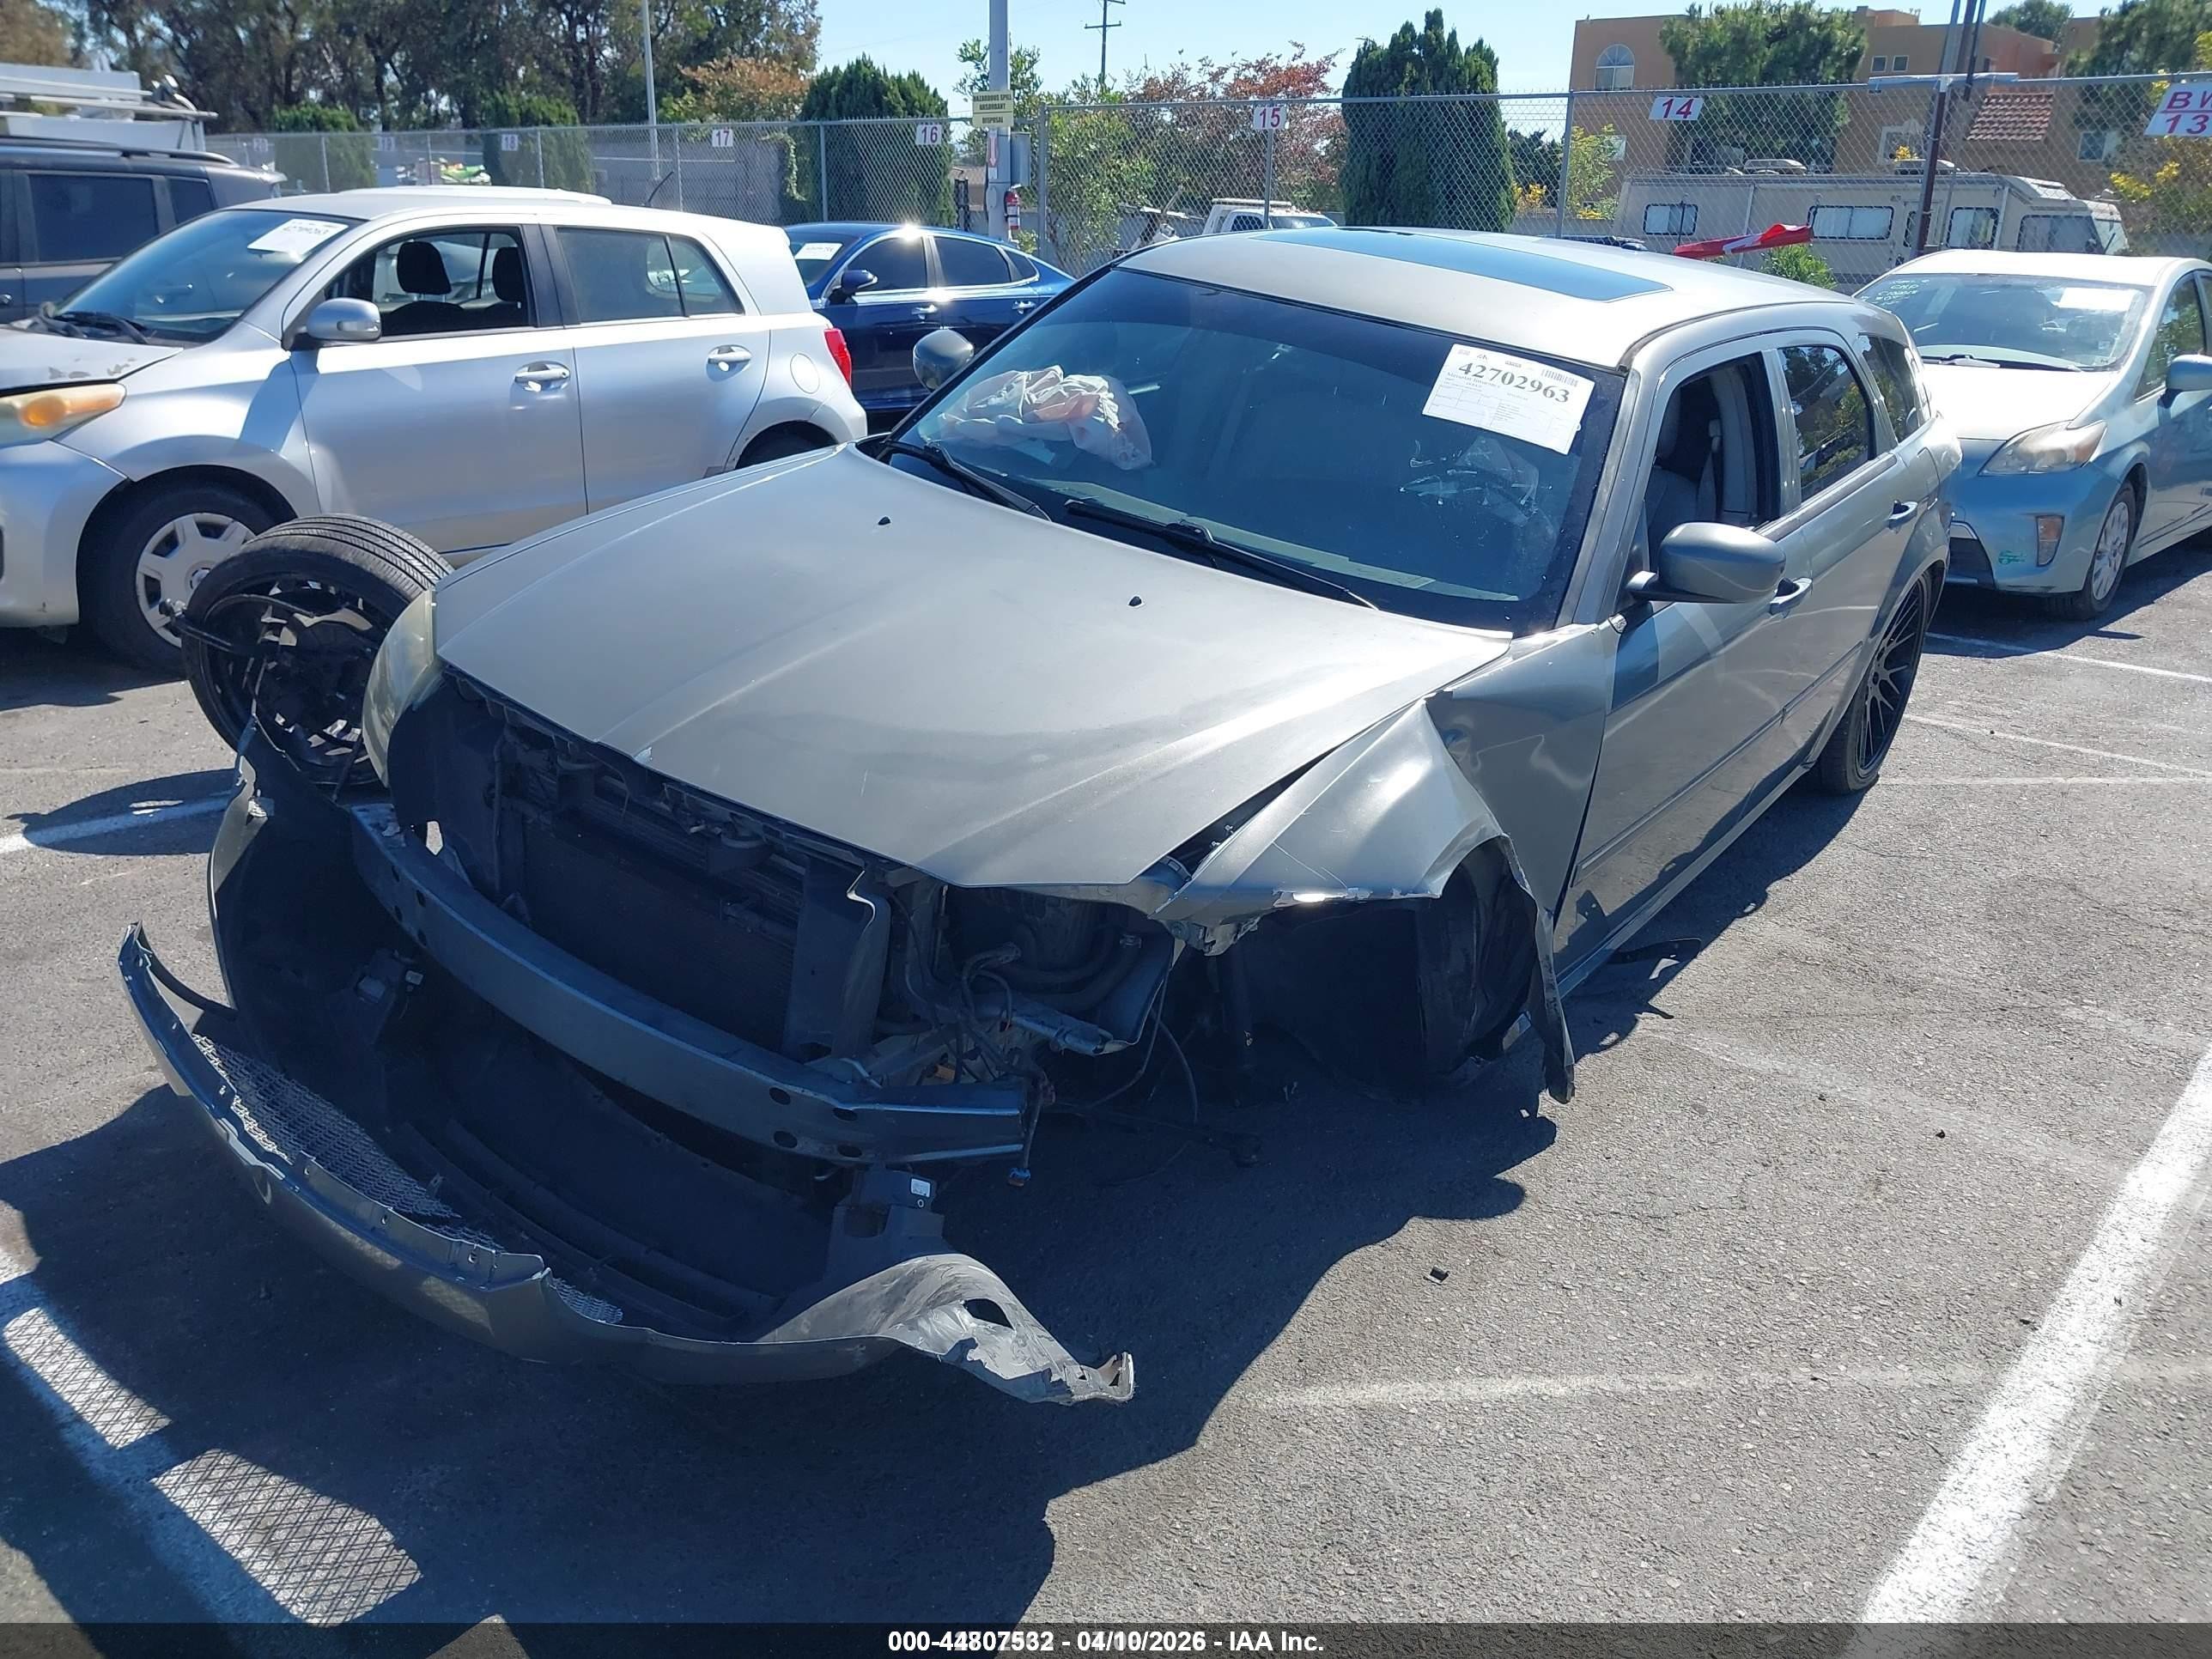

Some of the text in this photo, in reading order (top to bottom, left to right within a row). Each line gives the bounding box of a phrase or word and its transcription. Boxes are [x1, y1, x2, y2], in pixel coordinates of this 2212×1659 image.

[1260, 107, 1280, 128] 15
[1662, 98, 1694, 119] 14
[2166, 114, 2209, 134] 13
[716, 130, 729, 146] 17
[921, 126, 938, 144] 16
[1458, 362, 1571, 403] 42702963
